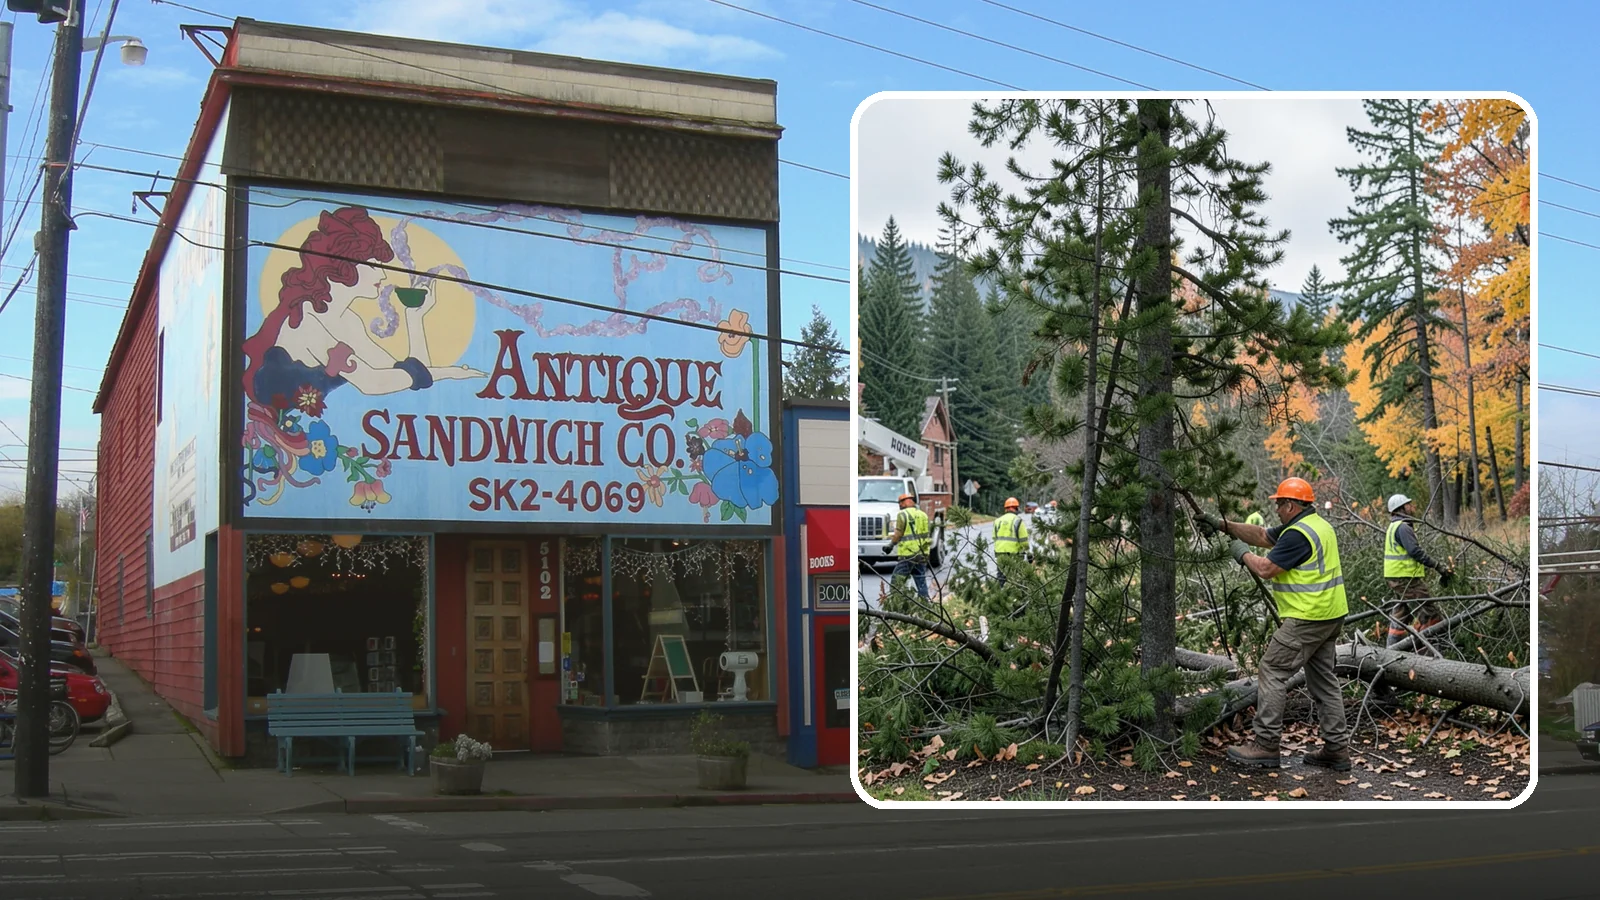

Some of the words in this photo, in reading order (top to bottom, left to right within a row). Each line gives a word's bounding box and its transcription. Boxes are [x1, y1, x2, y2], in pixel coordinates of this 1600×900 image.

[475, 329, 724, 421] ANTIQUE
[361, 408, 604, 467] SANDWICH
[616, 422, 685, 469] CO.
[468, 477, 646, 513] SK2-4069
[540, 541, 552, 599] 5102
[809, 555, 835, 569] BOOKS
